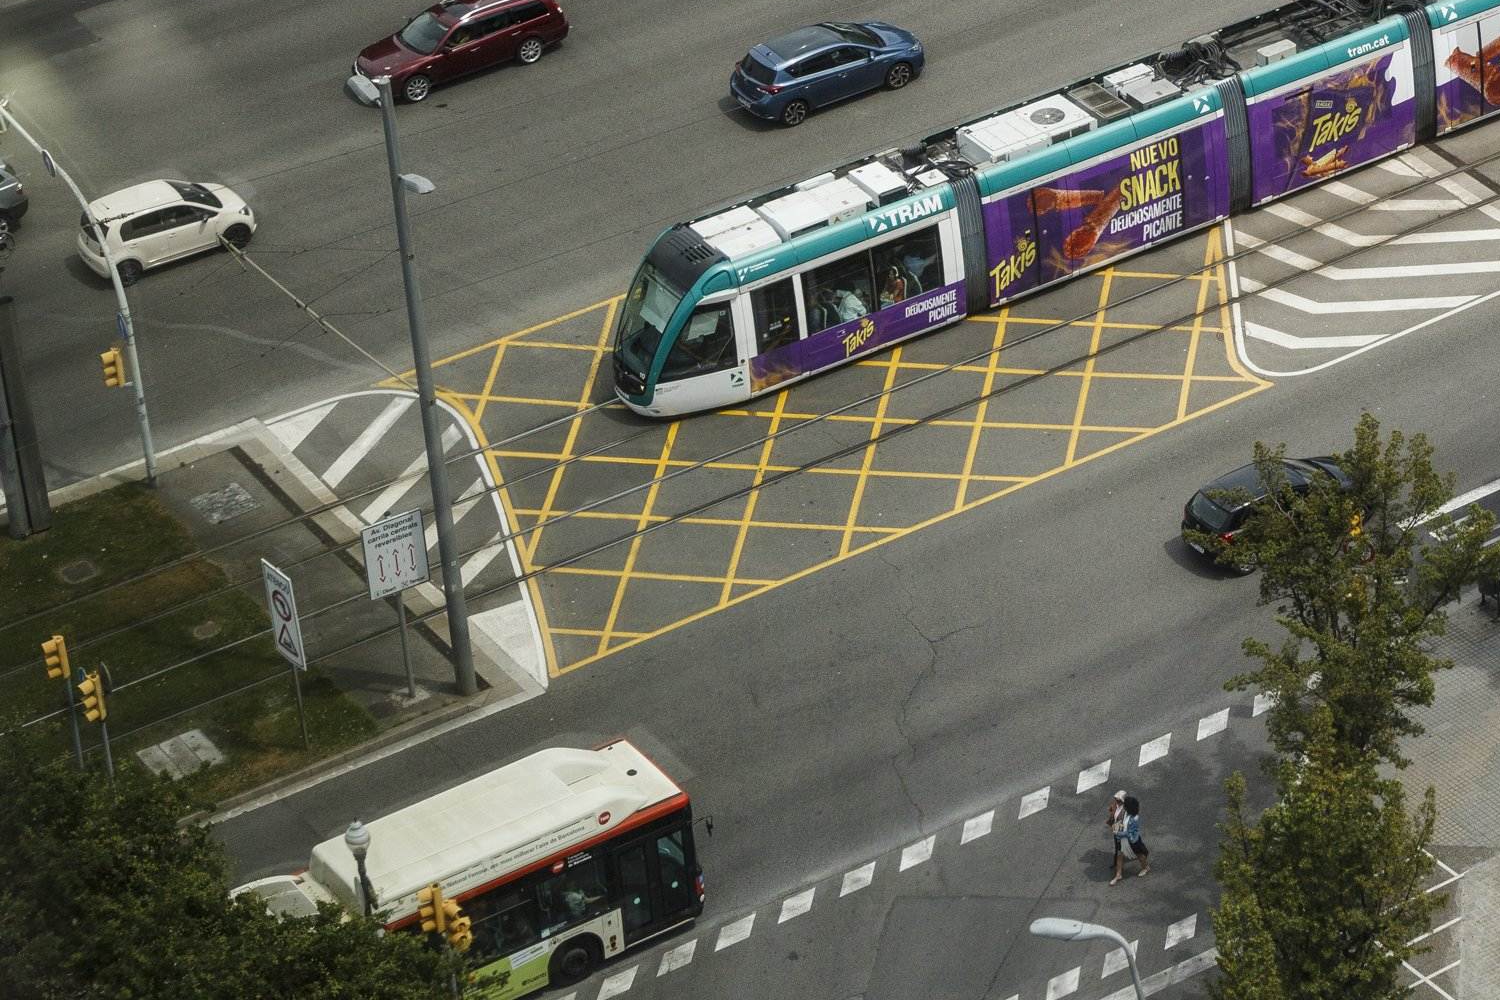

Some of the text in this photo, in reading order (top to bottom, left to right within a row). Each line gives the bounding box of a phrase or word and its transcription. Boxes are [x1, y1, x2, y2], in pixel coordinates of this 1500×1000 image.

[1346, 33, 1391, 58] tram.cat
[1309, 106, 1362, 153] Takis
[1130, 137, 1179, 172] NUEVO
[1119, 159, 1182, 212] SNACK
[888, 193, 944, 227] TRAM
[1110, 192, 1183, 235] DELICIOSAMENTE
[1143, 210, 1184, 242] PICANTE
[989, 241, 1037, 299] Takis
[904, 288, 957, 319] DELICIOSAMENTE
[928, 300, 957, 324] PICANTE
[842, 319, 875, 358] Takis
[383, 515, 414, 532] Diagonal
